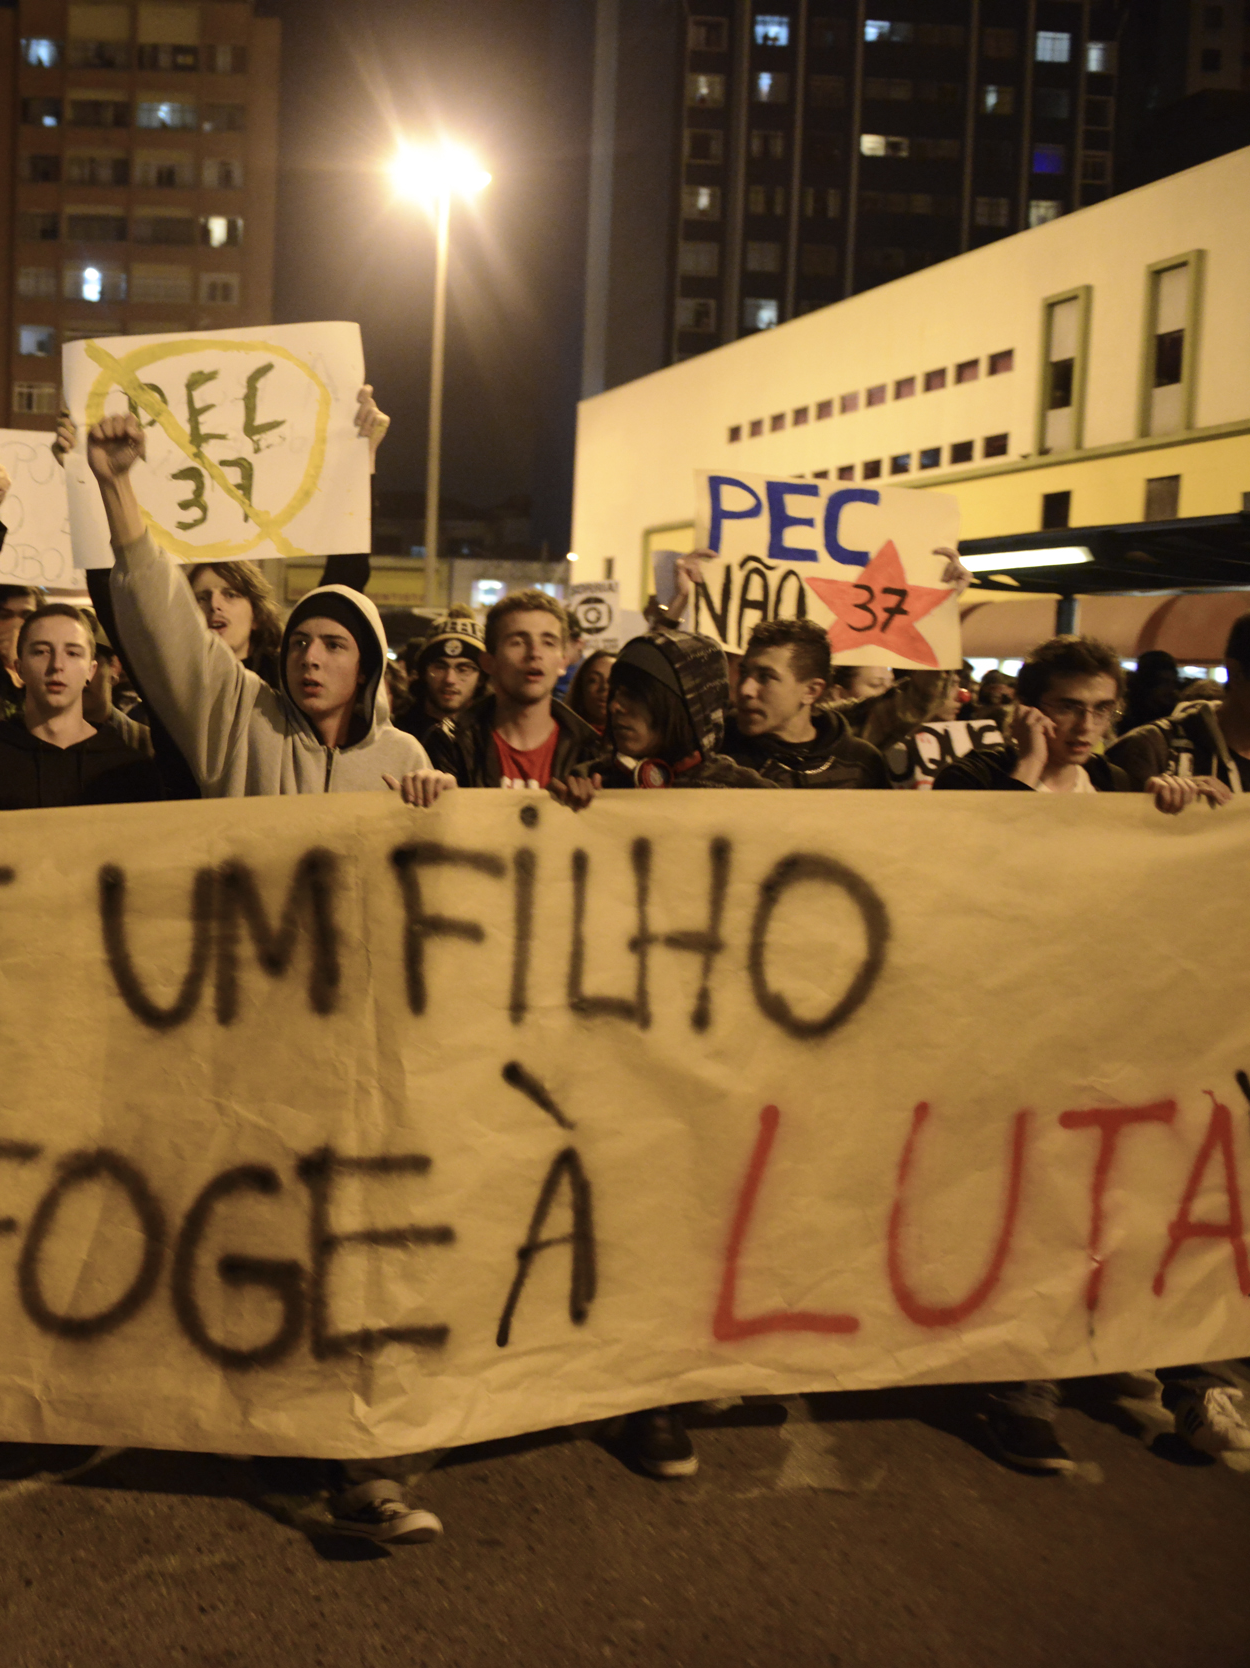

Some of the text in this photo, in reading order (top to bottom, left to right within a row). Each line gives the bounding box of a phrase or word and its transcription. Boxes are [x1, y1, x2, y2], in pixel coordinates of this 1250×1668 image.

[171, 457, 253, 531] 37
[708, 476, 880, 567] PEC
[695, 554, 806, 648] NÃO
[846, 583, 910, 633] 37
[98, 846, 342, 1031] UM
[390, 804, 893, 1041] FILHO
[500, 1060, 597, 1348] À
[711, 1089, 1250, 1342] LUTA
